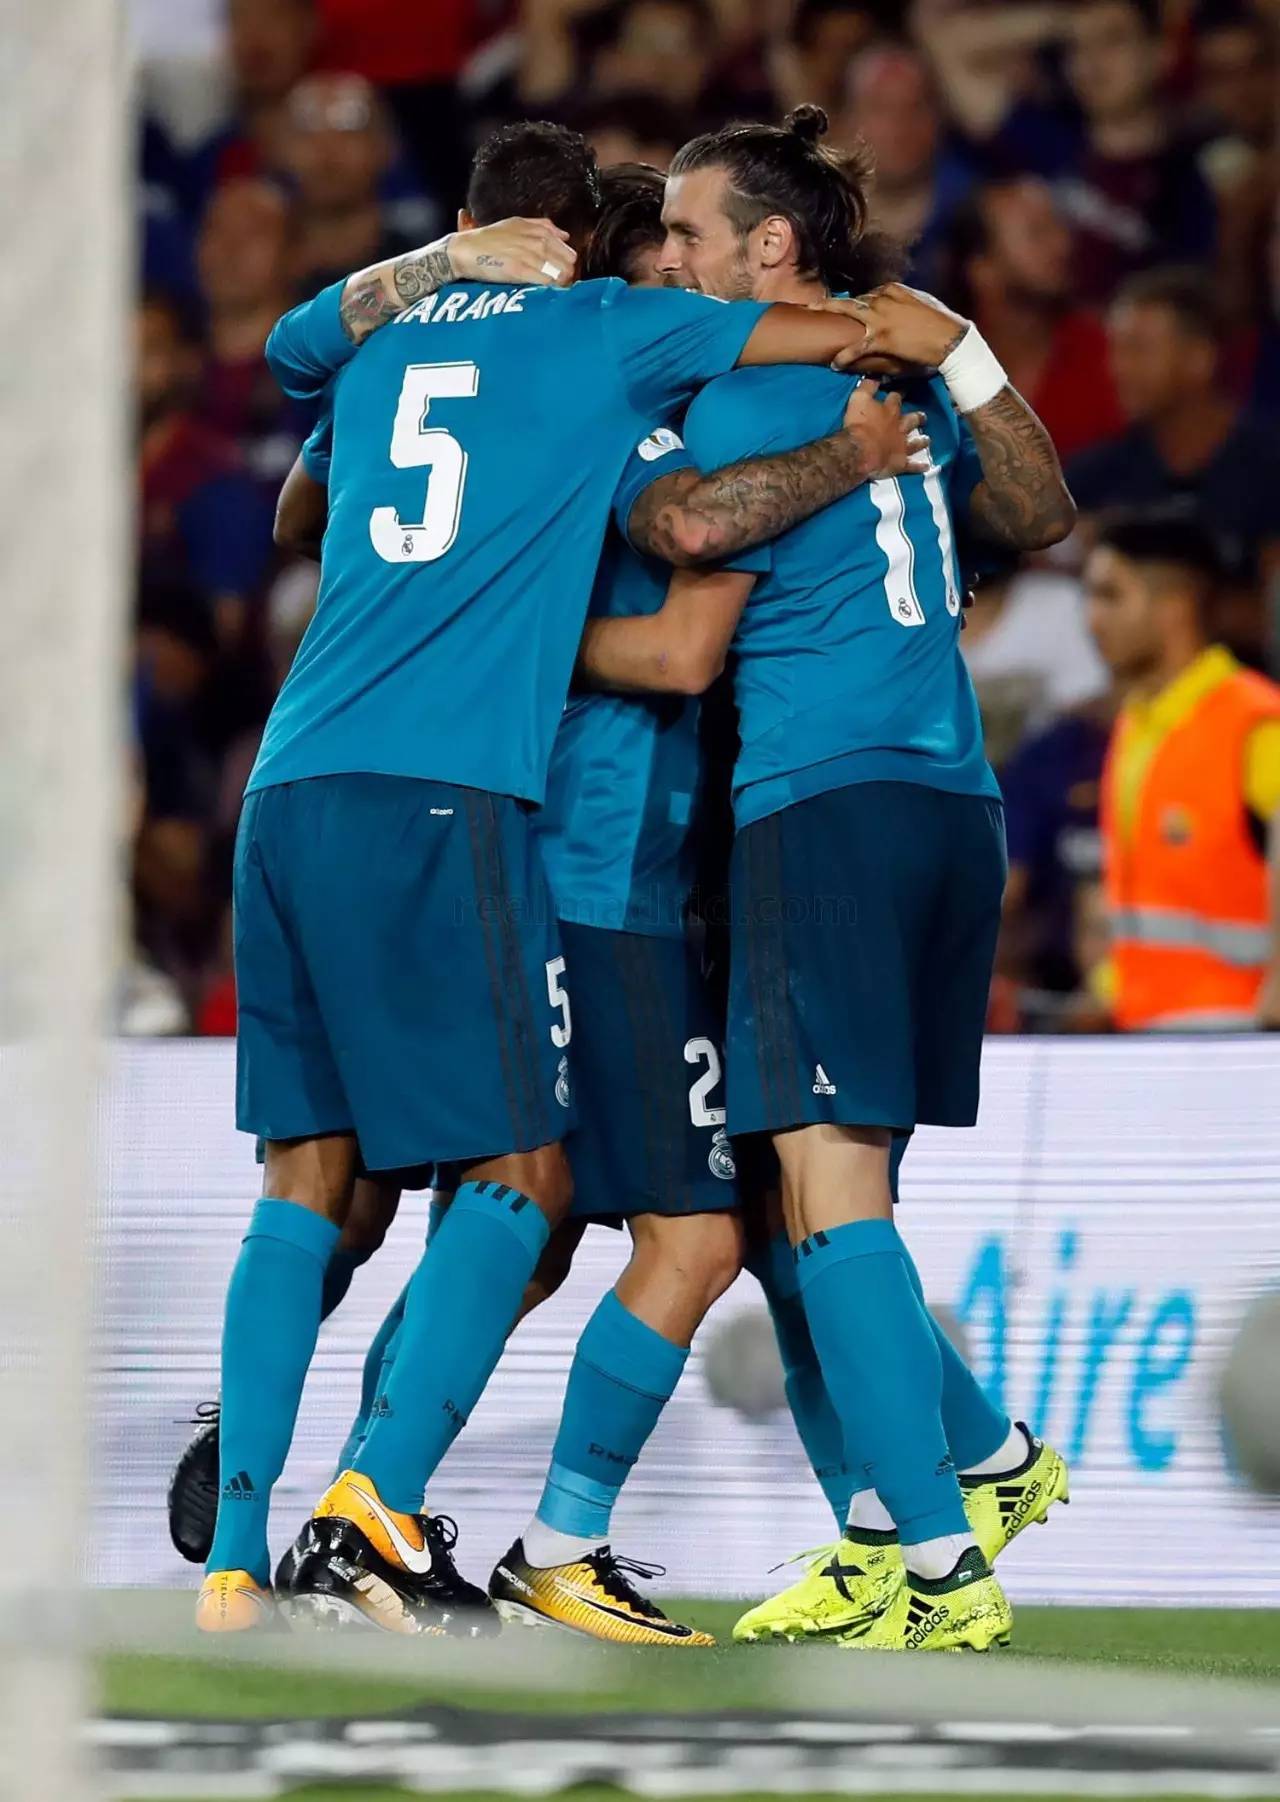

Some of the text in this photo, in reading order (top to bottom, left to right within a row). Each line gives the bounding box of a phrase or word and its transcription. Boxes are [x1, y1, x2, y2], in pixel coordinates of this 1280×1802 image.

[369, 360, 480, 564] 5
[869, 428, 960, 627] 11
[545, 955, 572, 1048] 5
[684, 1036, 727, 1127] 2
[1005, 1479, 1042, 1540] adidas
[905, 1605, 950, 1650] adidas
